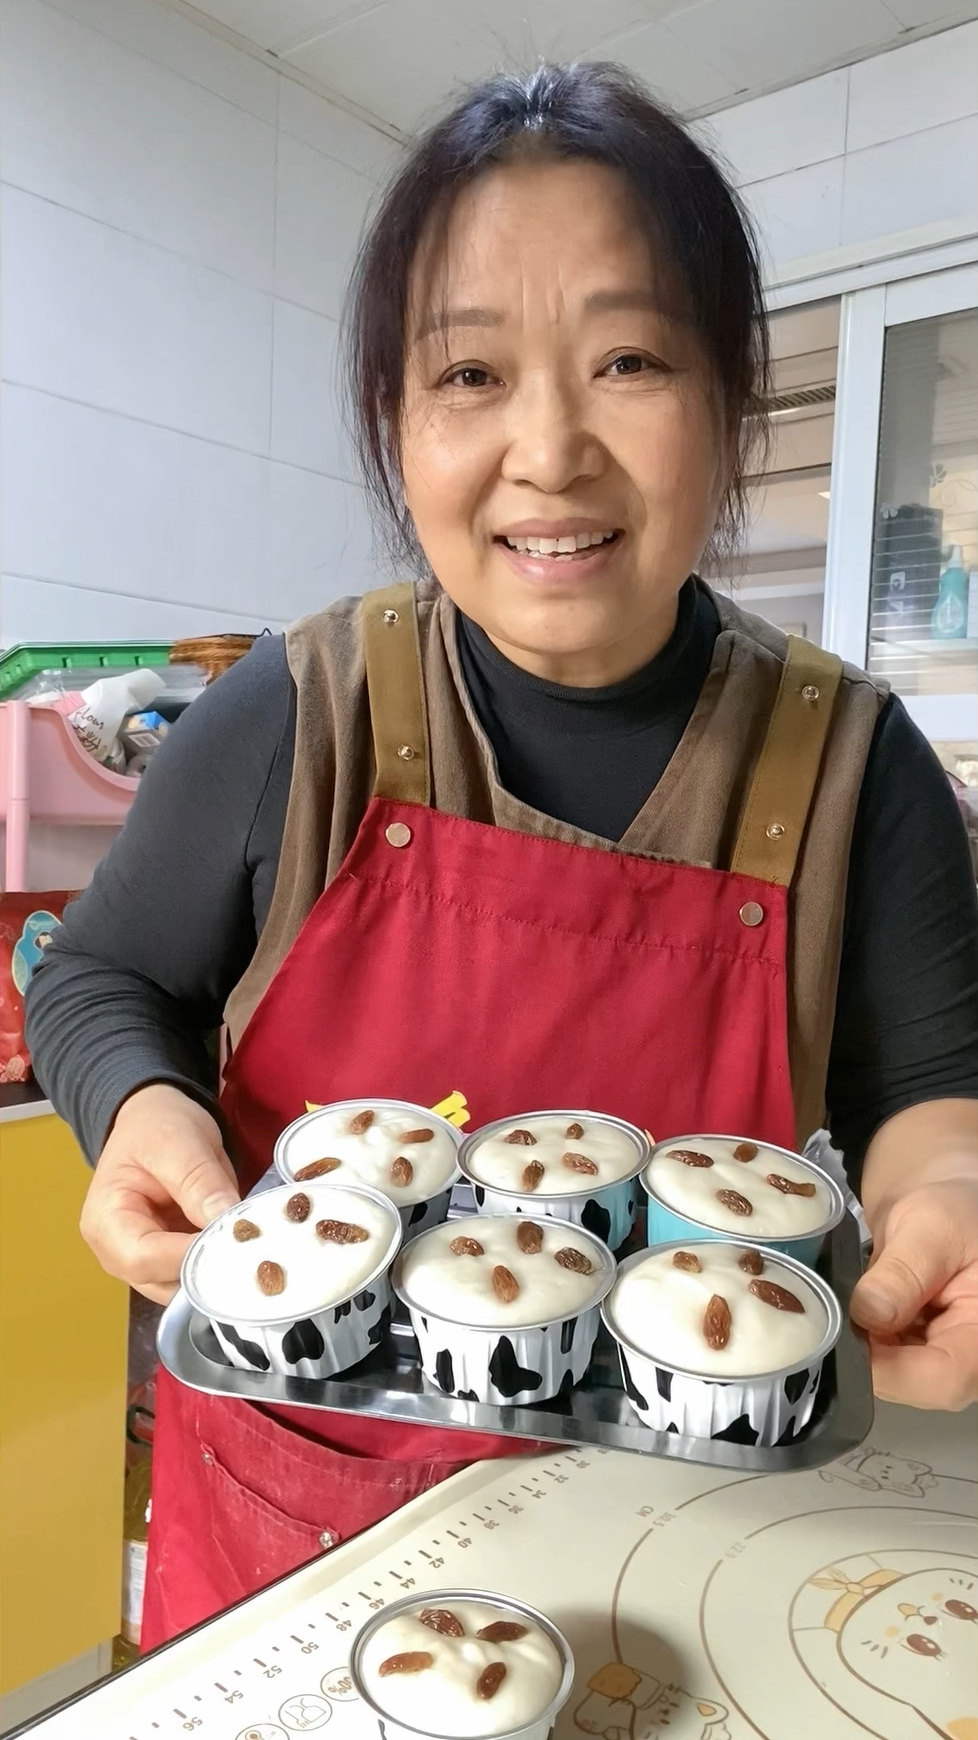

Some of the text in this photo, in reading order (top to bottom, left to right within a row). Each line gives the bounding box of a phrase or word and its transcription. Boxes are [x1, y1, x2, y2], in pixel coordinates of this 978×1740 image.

[554, 1474, 569, 1484] 32
[532, 1489, 547, 1499] 34
[508, 1504, 524, 1515] 36
[635, 1505, 654, 1518] CM
[484, 1519, 500, 1531] 38
[458, 1537, 472, 1549] 40
[429, 1557, 445, 1569] 42
[400, 1577, 416, 1590] 44
[369, 1598, 385, 1610] 46
[336, 1619, 352, 1632] 48
[300, 1641, 319, 1655] 50
[262, 1665, 283, 1679] 52
[224, 1690, 244, 1704] 54
[182, 1716, 204, 1732] 56
